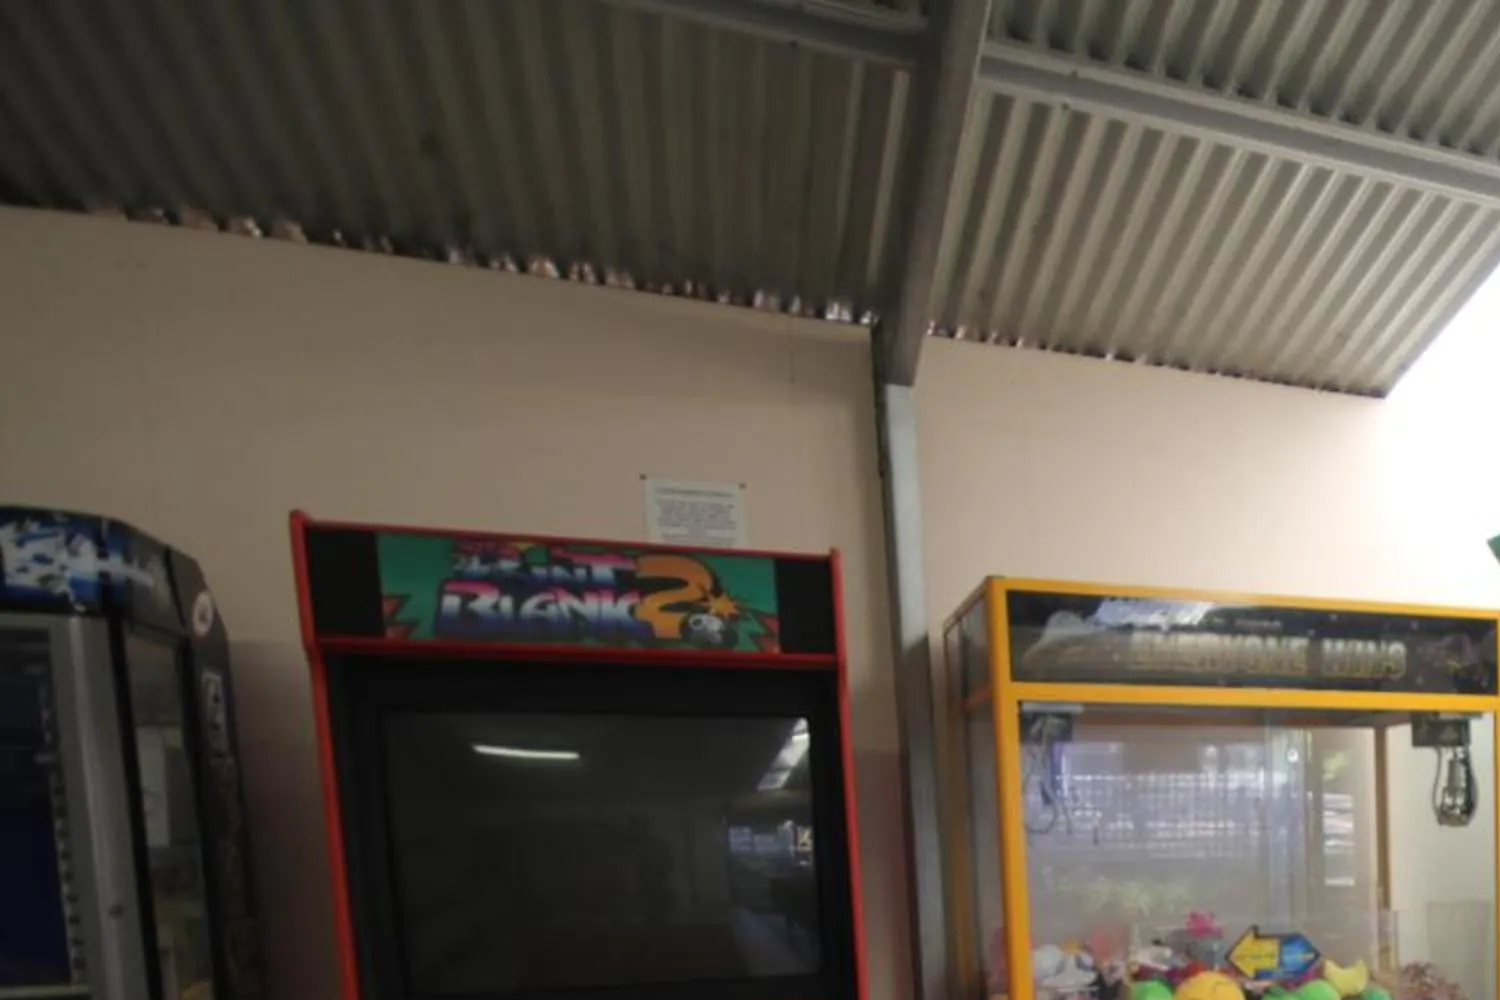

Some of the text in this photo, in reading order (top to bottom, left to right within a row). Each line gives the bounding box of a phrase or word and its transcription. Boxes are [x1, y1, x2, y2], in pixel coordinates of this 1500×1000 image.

[438, 554, 718, 640] BLANK 2
[1321, 637, 1408, 680] WINS
